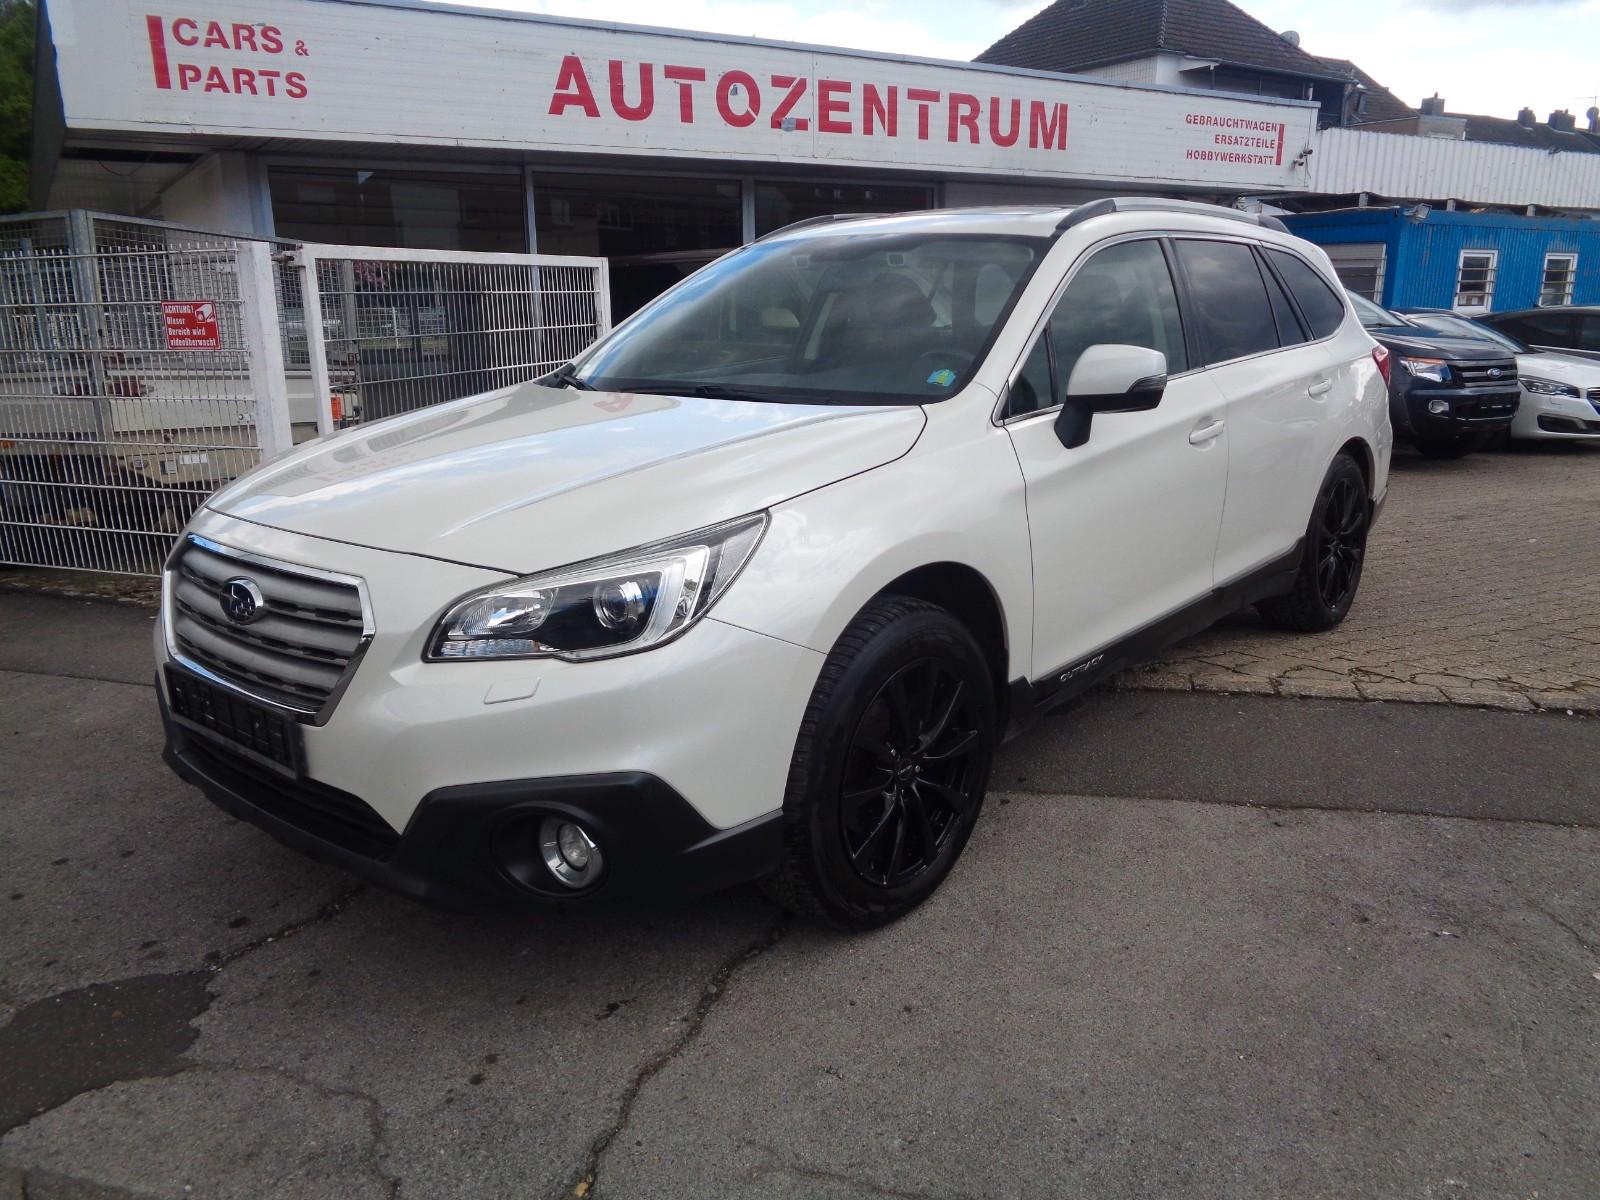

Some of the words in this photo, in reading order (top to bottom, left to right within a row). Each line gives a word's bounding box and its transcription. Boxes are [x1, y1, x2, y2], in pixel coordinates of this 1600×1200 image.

[172, 18, 283, 53] CARS
[295, 40, 310, 56] &
[177, 63, 308, 99] PARTS
[547, 55, 1069, 151] AUTOZENTRUM
[1185, 114, 1277, 132] GEBRAUCHTWAGEN
[1214, 134, 1275, 149] ERSATZTEILE
[1186, 149, 1274, 165] HOBBYWERKSTATT
[192, 327, 206, 335] wird
